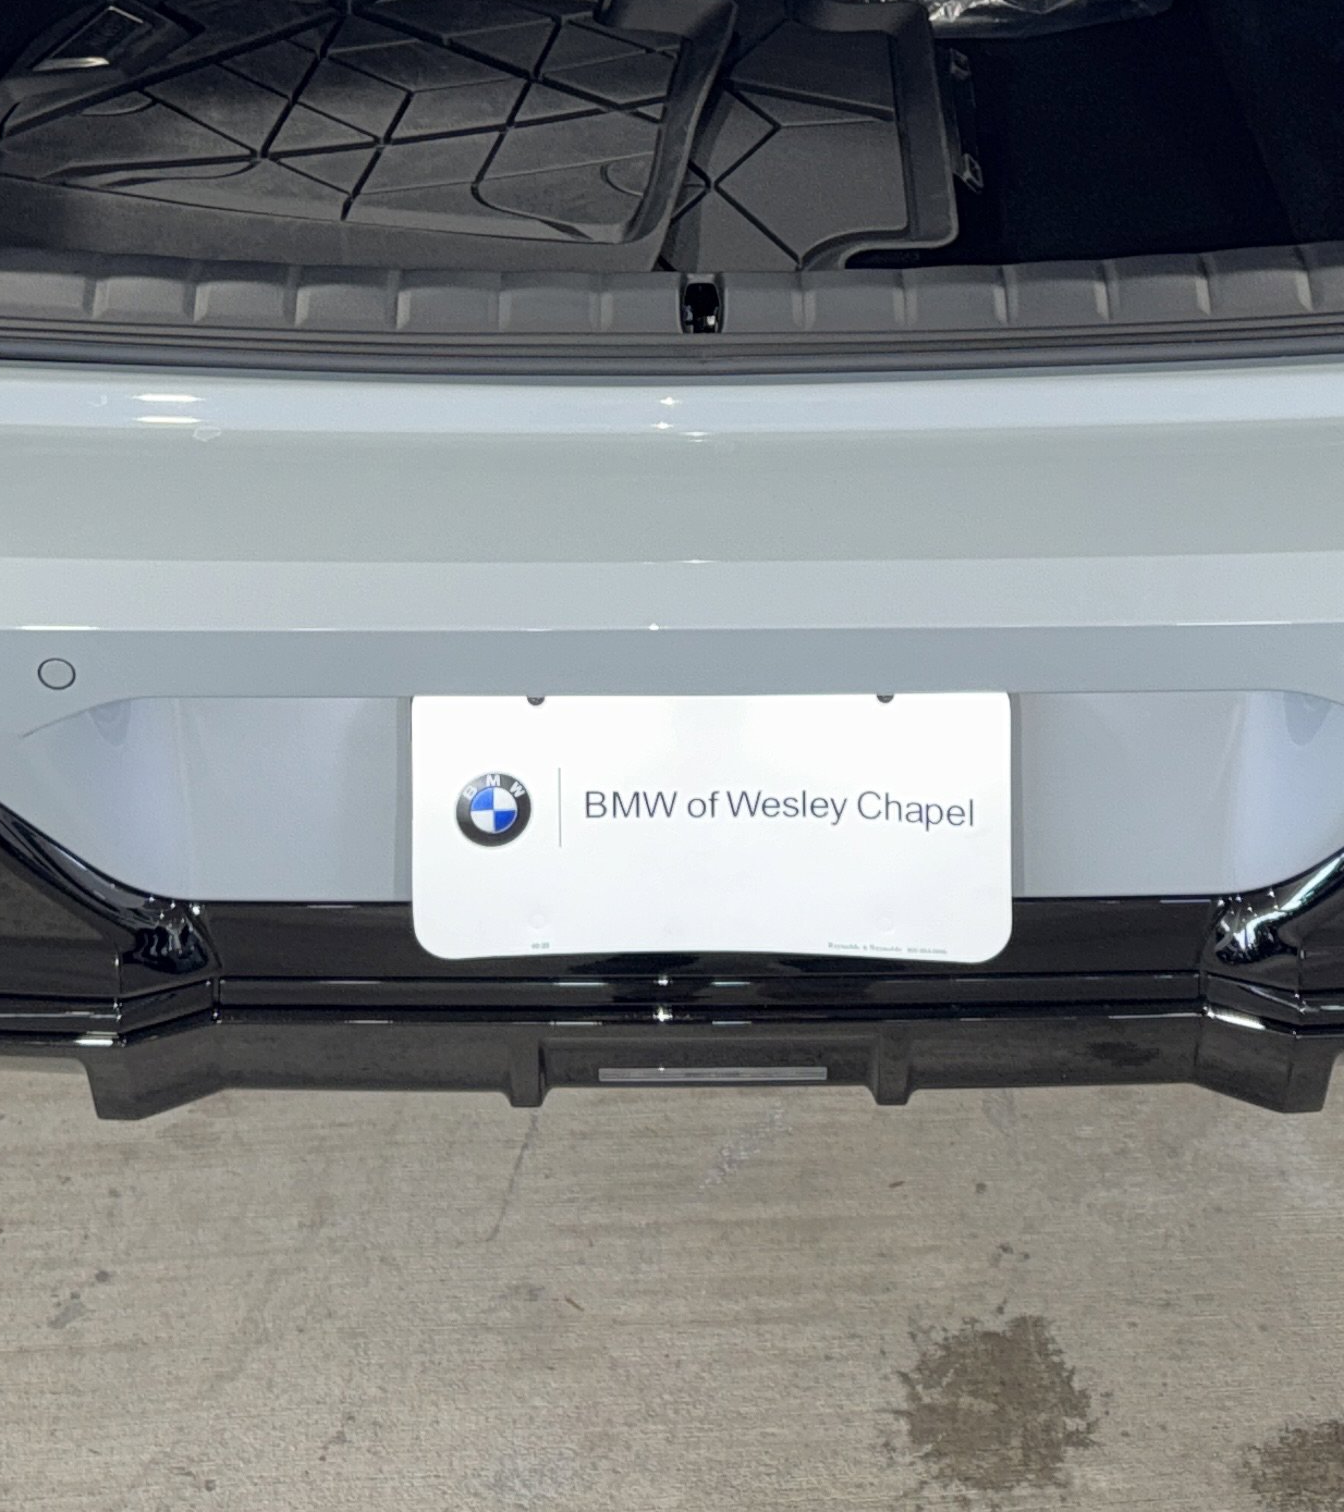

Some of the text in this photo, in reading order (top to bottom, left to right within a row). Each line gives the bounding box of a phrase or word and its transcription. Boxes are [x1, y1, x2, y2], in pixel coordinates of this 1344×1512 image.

[462, 774, 526, 801] BMW
[585, 789, 974, 832] BMW of Wesley Chapel
